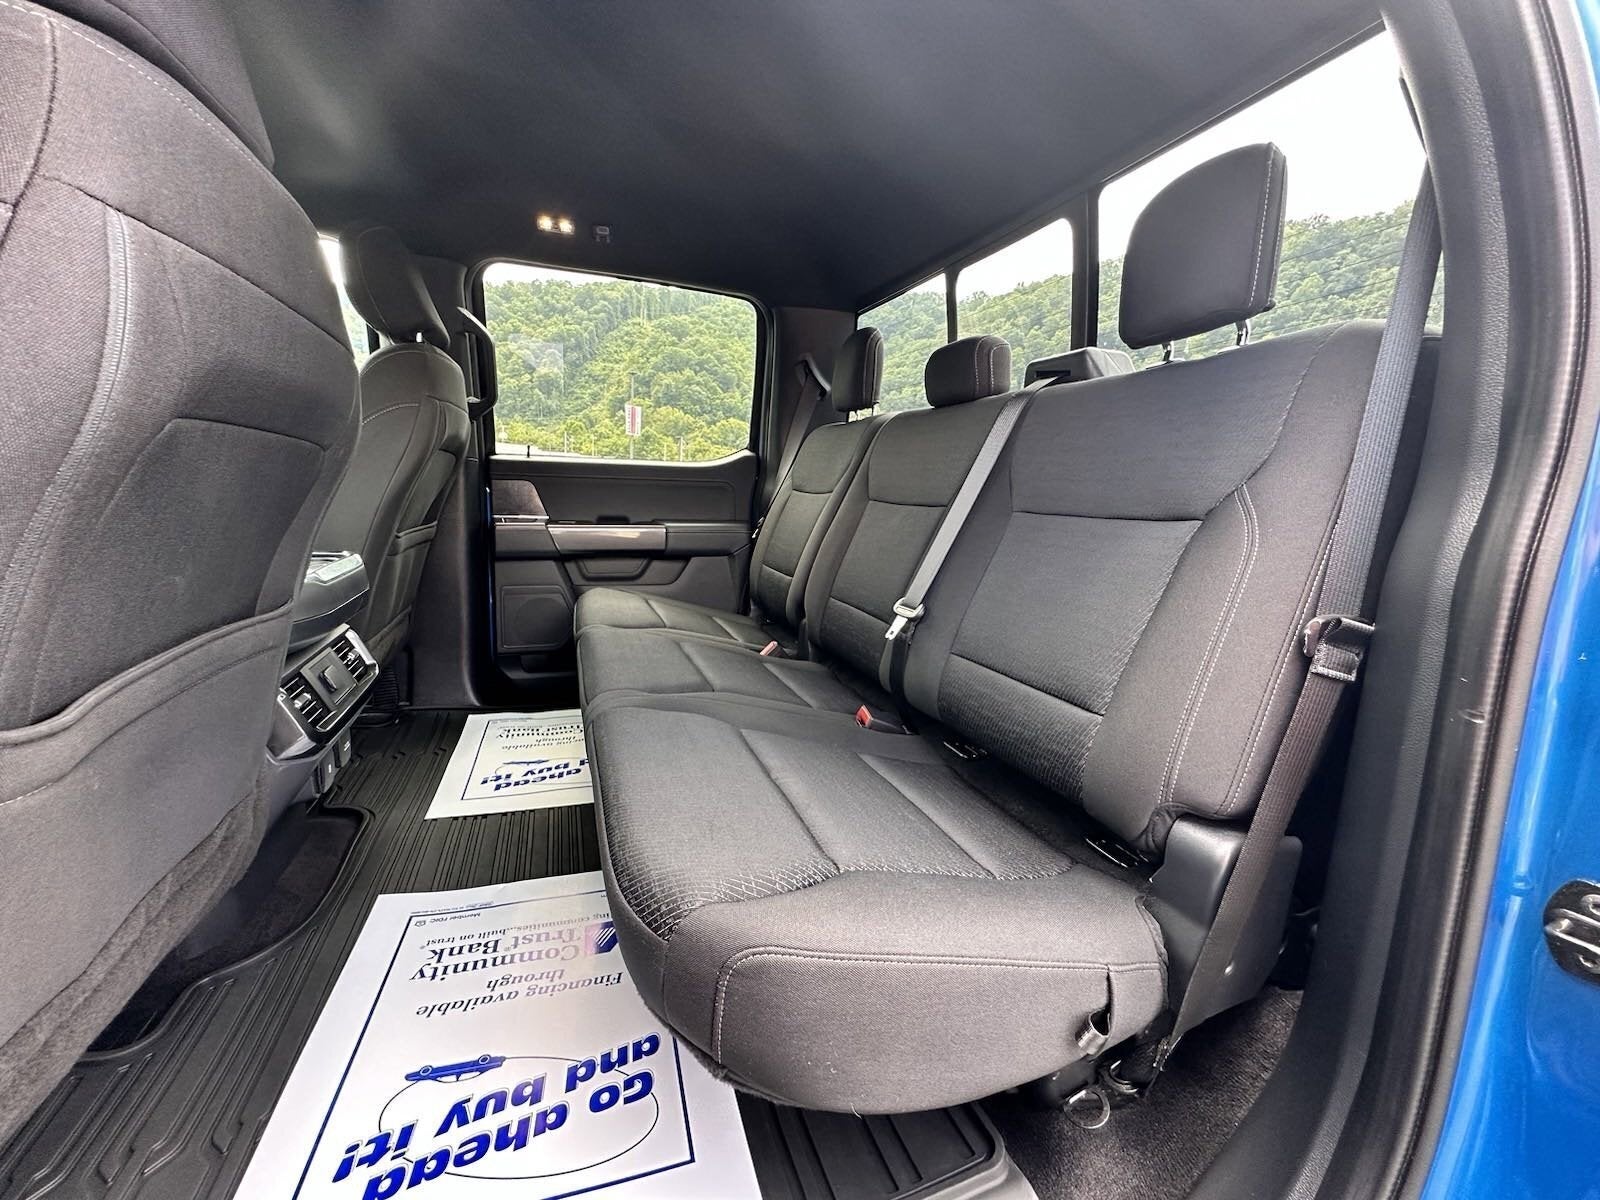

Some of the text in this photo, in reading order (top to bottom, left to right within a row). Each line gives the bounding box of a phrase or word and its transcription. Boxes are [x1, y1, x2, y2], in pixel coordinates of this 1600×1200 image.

[480, 773, 512, 785] it!
[493, 768, 582, 791] ahead
[522, 761, 570, 777] buy
[450, 912, 481, 921] Member
[409, 944, 579, 982] Community
[429, 938, 502, 965] Bank
[486, 968, 566, 992] through
[416, 971, 624, 1018] Financing available
[332, 1032, 662, 1183] and buy it!
[361, 1068, 656, 1200] Go ahead
